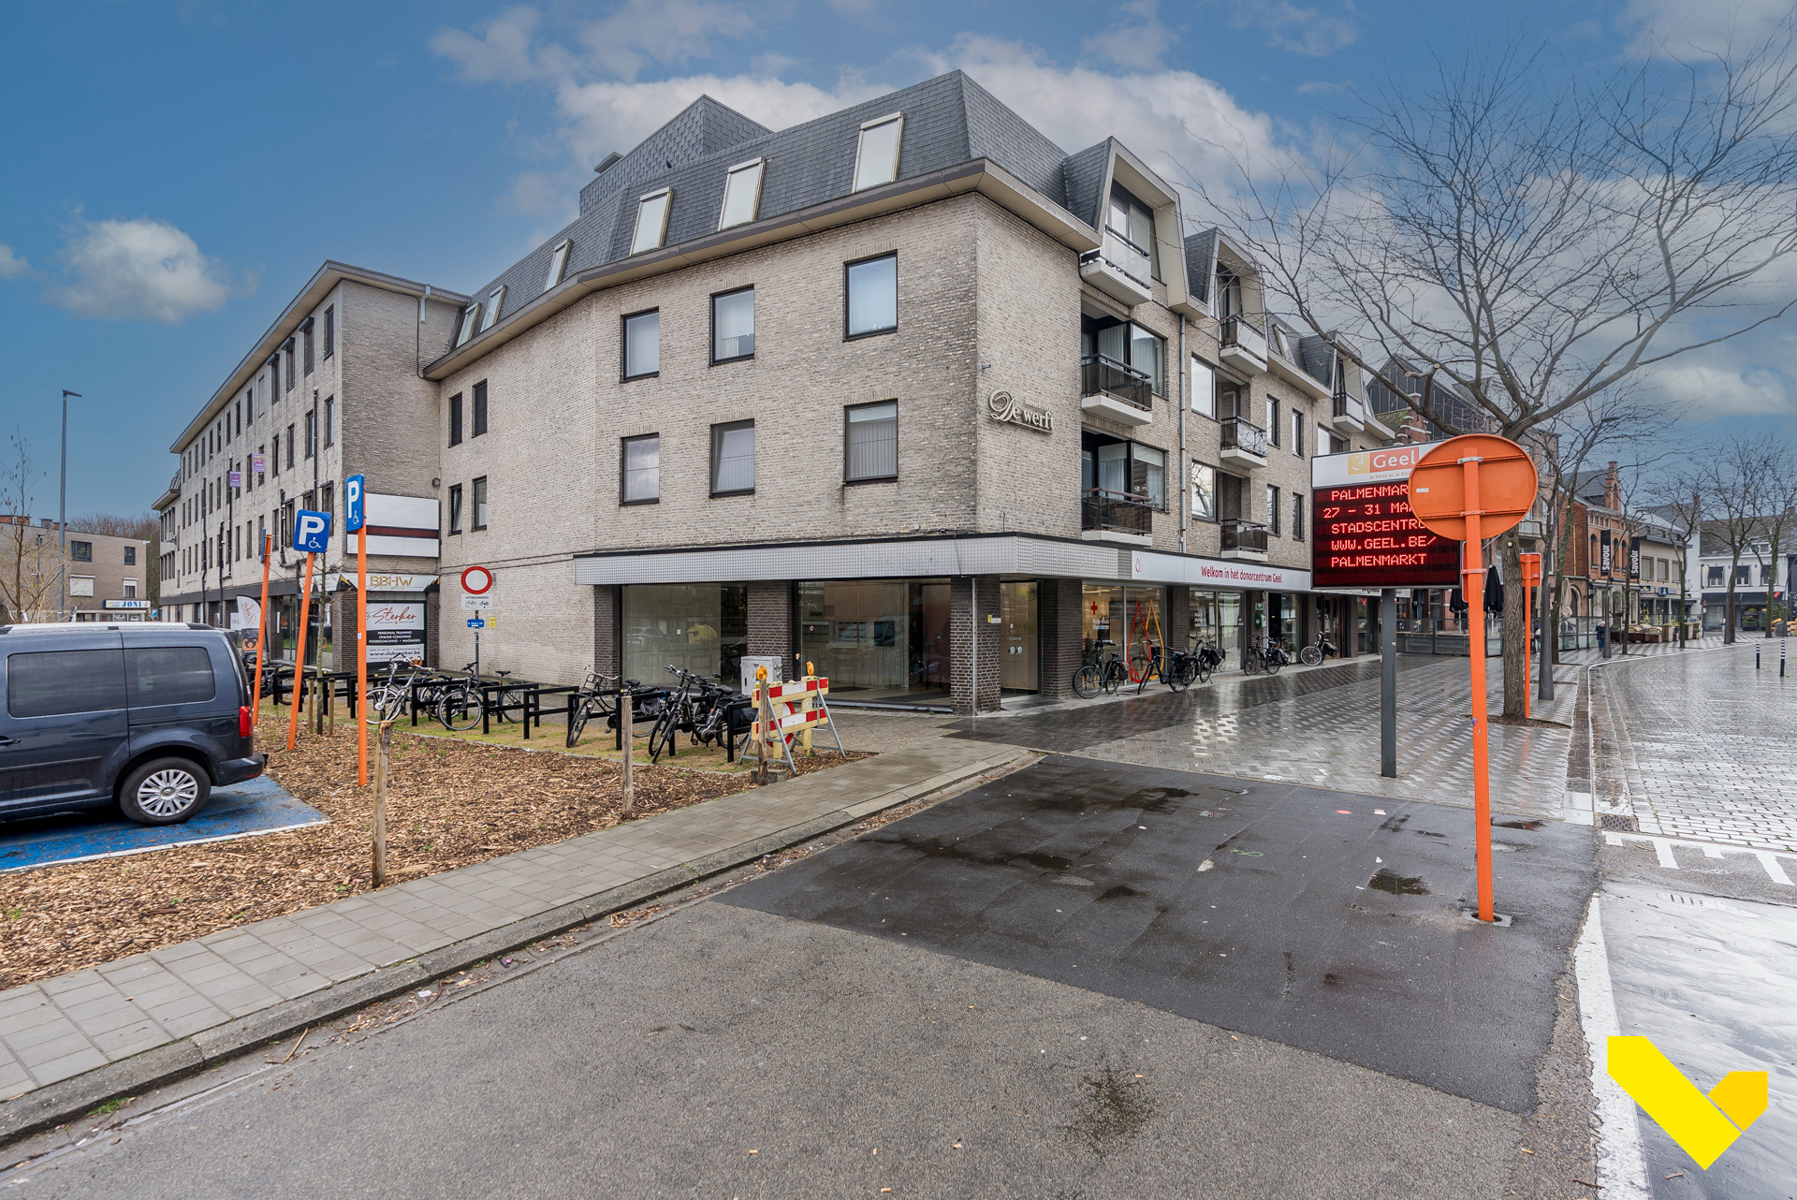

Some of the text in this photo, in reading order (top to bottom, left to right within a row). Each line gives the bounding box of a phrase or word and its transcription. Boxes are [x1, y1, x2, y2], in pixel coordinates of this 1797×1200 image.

[1373, 449, 1416, 469] Geel
[347, 480, 360, 519] P
[1331, 483, 1408, 501] PALMENMAR
[1323, 507, 1340, 519] 27
[1364, 503, 1381, 515] 31
[298, 515, 325, 545] P
[1331, 553, 1428, 568] PALMENMARKT
[1201, 565, 1283, 583] Welkom in het donorcentrum Geel
[372, 606, 417, 624] Sterker
